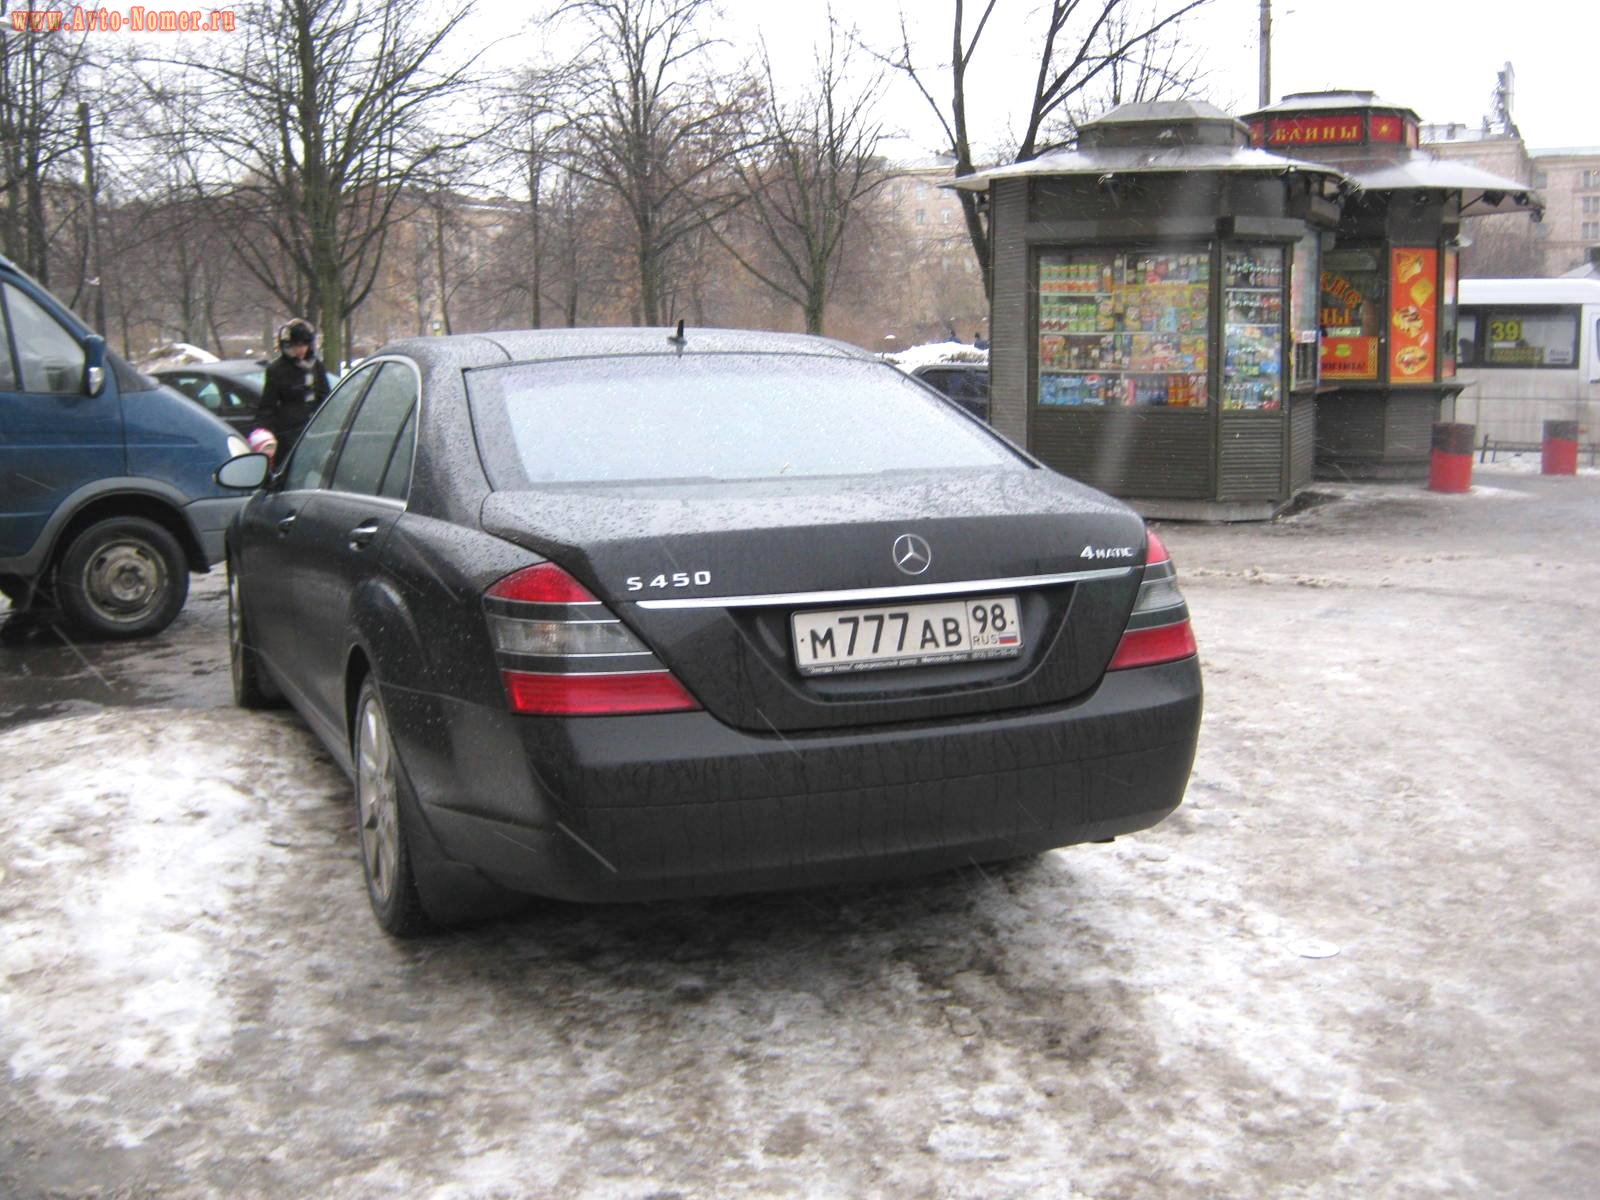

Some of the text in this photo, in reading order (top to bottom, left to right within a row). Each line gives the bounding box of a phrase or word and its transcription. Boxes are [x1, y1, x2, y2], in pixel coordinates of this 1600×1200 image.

[1275, 125, 1358, 141] БЛИНЫ
[1489, 319, 1520, 342] 39
[1080, 545, 1134, 560] 4MATIC
[626, 570, 711, 591] S 450
[971, 603, 1008, 634] 98
[972, 634, 999, 646] RUS
